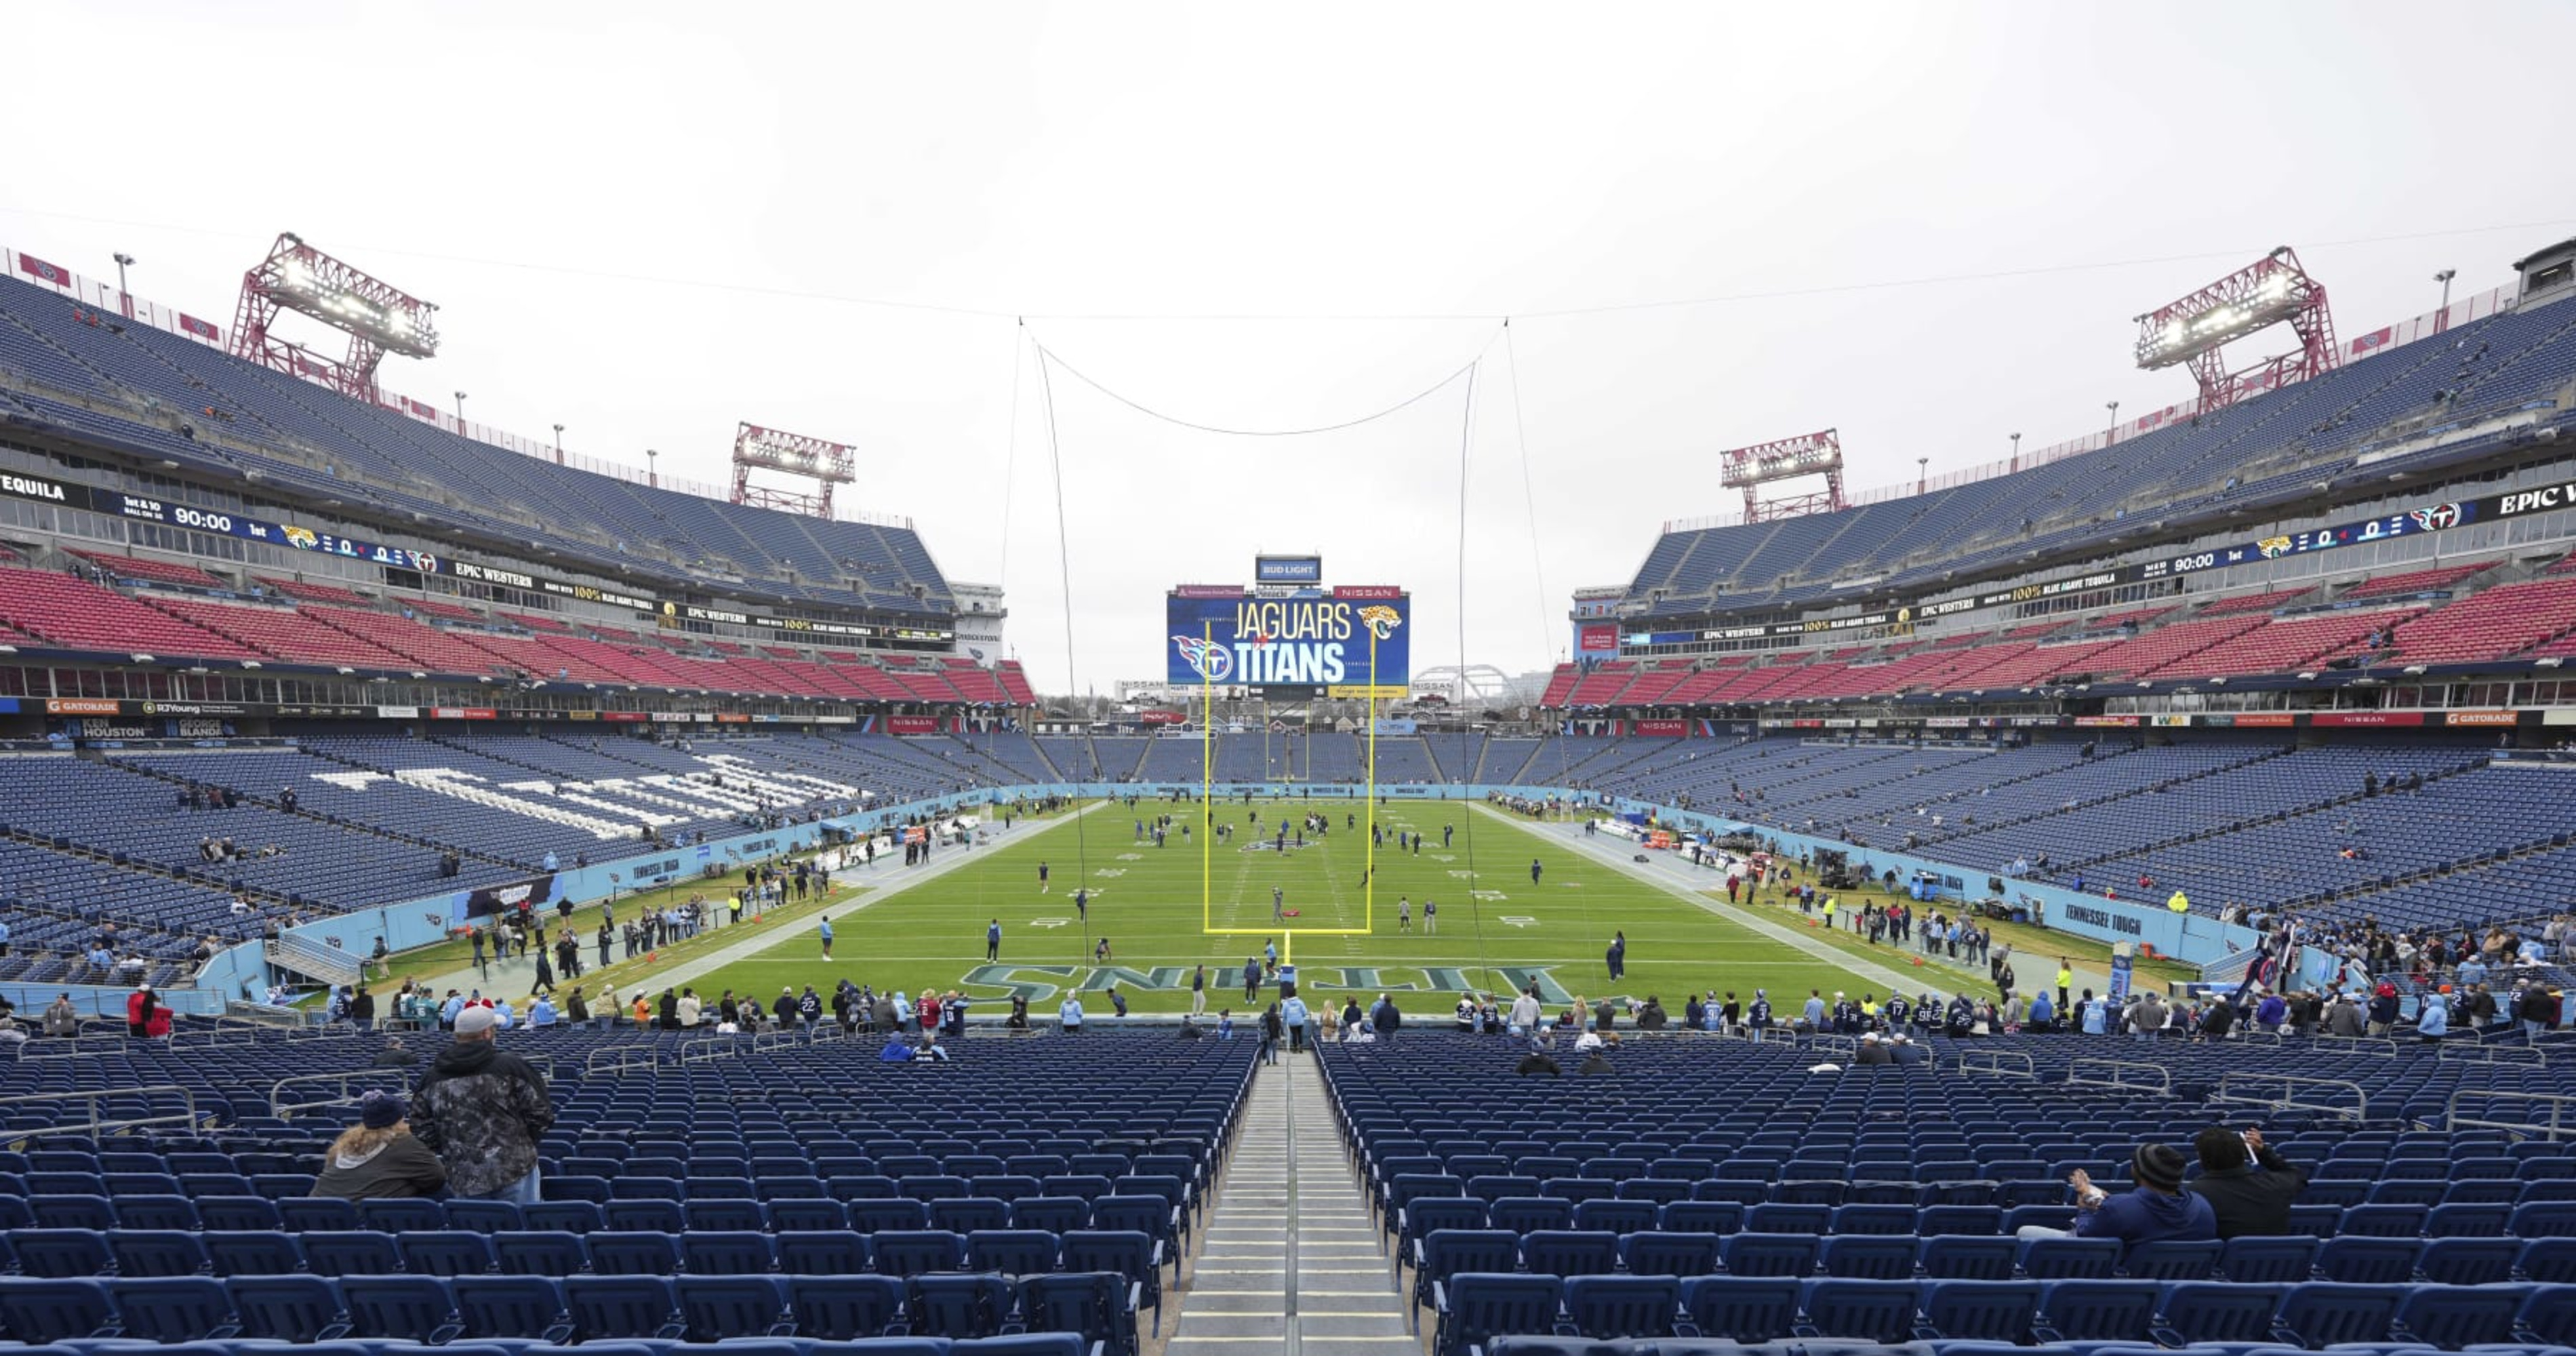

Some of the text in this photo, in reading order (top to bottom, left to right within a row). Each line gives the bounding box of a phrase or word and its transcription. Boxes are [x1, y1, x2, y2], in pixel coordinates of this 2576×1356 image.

[0, 475, 65, 500] EQUILA
[2500, 488, 2558, 515] EPIC
[175, 508, 231, 532] 90:00
[248, 523, 266, 538] 1st
[2366, 521, 2379, 536] 0
[2318, 530, 2331, 543] 0
[341, 540, 351, 553] 0
[377, 547, 387, 559] 0
[2175, 553, 2213, 572] 90:00
[2229, 551, 2242, 561] 1st
[456, 562, 532, 588] EPIC WESTERN
[1263, 565, 1314, 574] BUD LIGHT
[575, 586, 601, 601] 100%
[1342, 589, 1392, 597] NISSAN
[2012, 585, 2042, 601] 100%
[2043, 582, 2060, 595] BLUE
[2061, 578, 2083, 591] AGAVE
[2085, 573, 2115, 587] TEQUILA
[1920, 598, 1975, 617] EPIC WESTERN
[688, 607, 746, 623] EPIC WESTERN
[1234, 602, 1351, 639] JAGUARS
[784, 620, 811, 631] 100%
[1804, 621, 1830, 632] 100%
[1704, 627, 1765, 640] EPIC WESTERN
[1234, 643, 1344, 682] TITANS
[1414, 682, 1454, 690] NISSAN
[63, 702, 117, 711] GATORADE
[2460, 714, 2515, 723] GATORADE
[83, 727, 145, 738] HOUSTON
[180, 727, 224, 736] BLANDA
[2065, 904, 2141, 936] TENNESSEE TOUGH
[803, 1001, 815, 1012] 22
[1893, 1005, 1904, 1016] 17
[1460, 1008, 1472, 1019] 22
